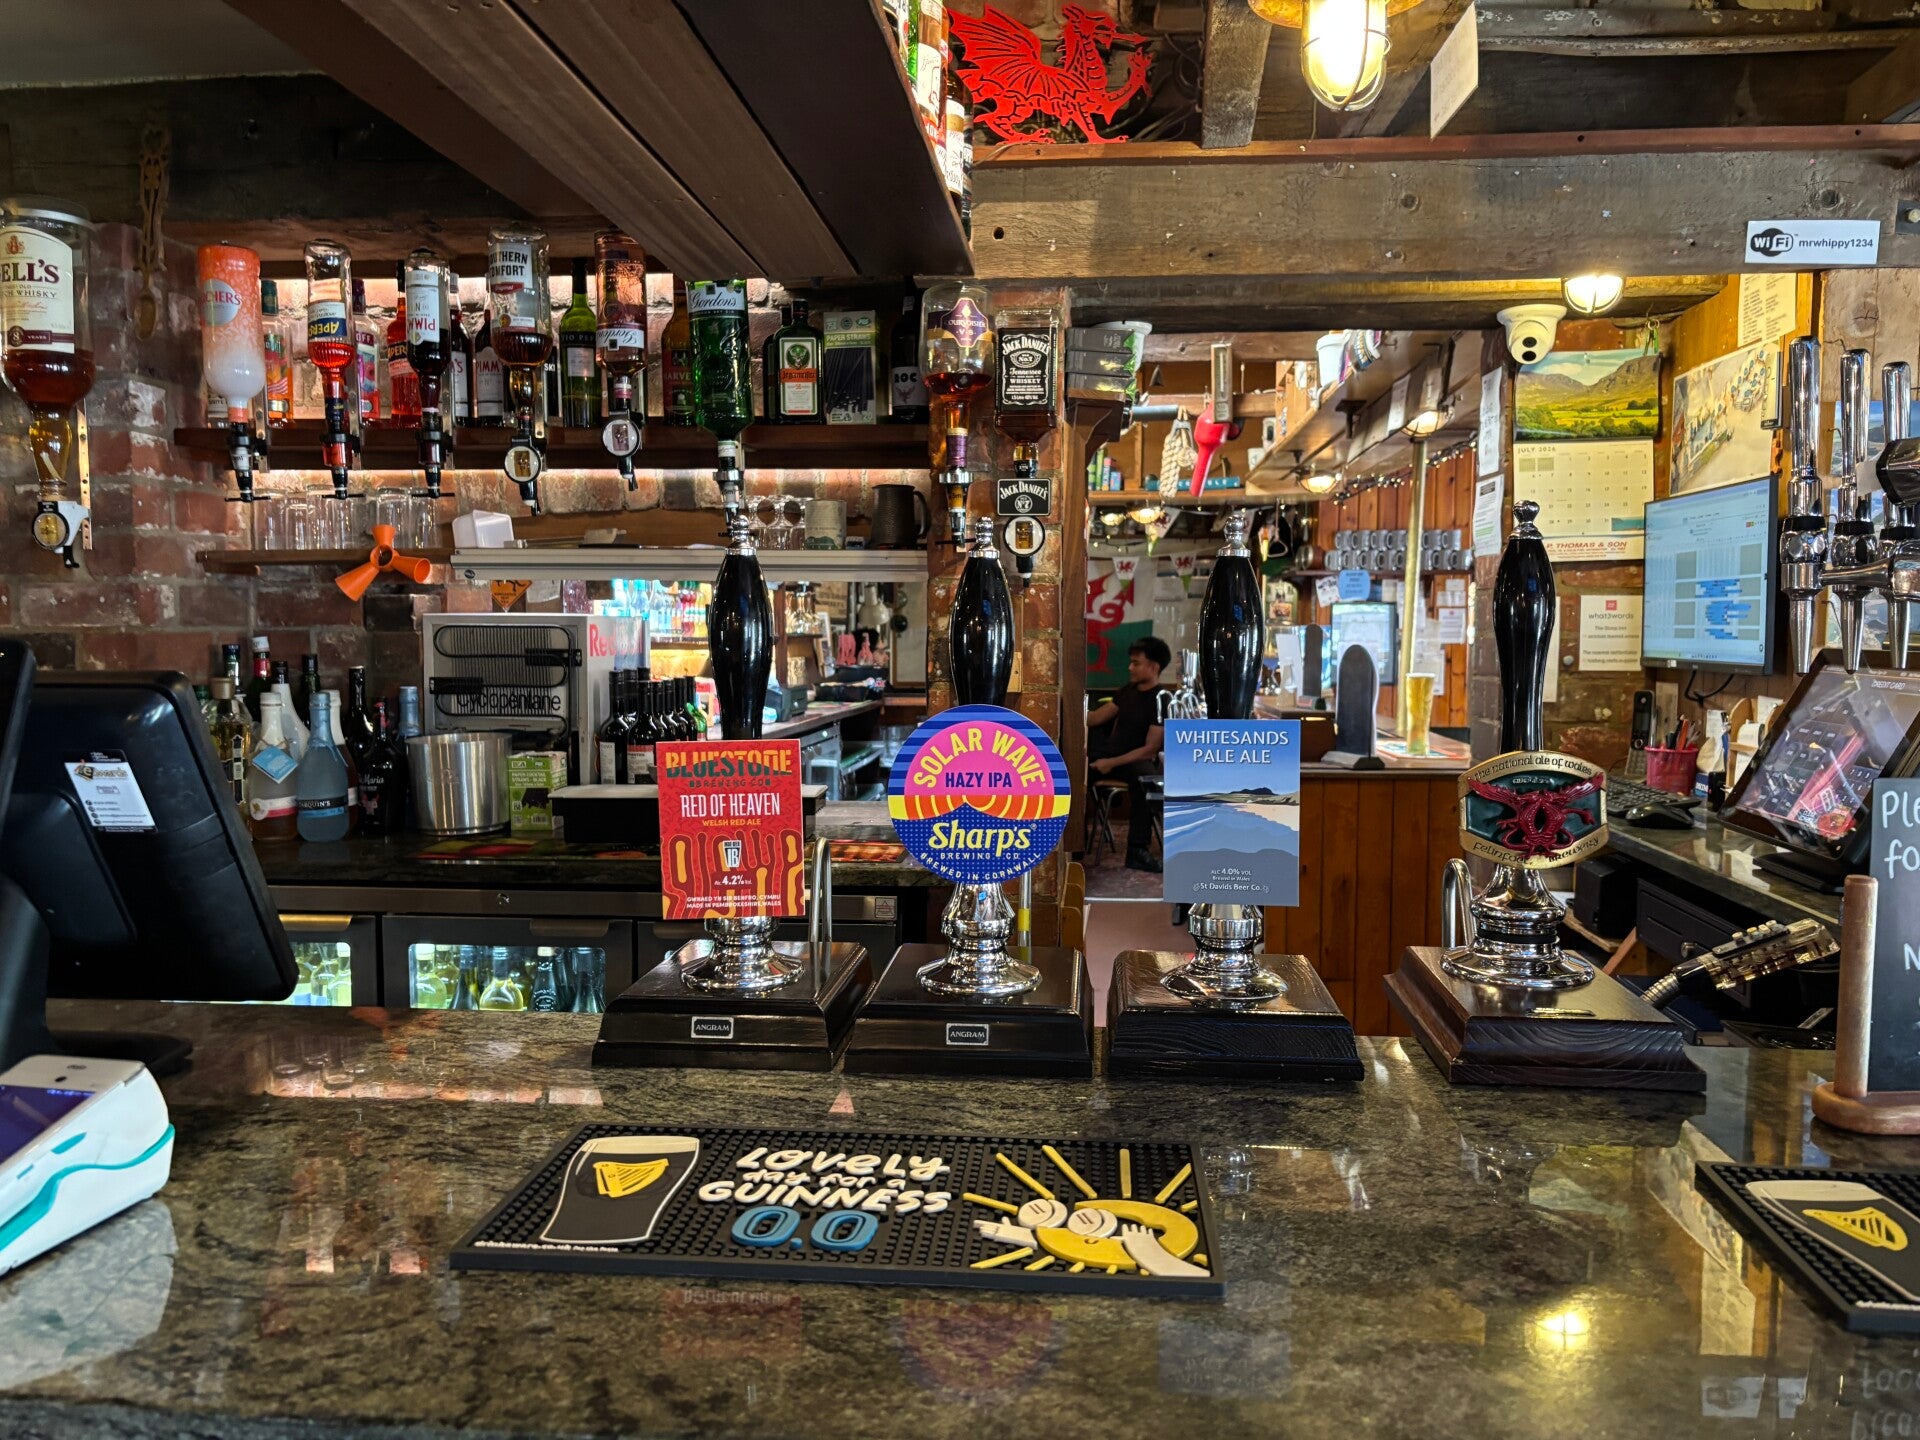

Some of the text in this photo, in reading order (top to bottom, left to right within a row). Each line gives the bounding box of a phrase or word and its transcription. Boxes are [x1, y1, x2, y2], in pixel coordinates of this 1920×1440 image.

[1798, 238, 1873, 249] mrwhippy1234
[0, 259, 60, 284] ELL'S
[16, 290, 57, 298] WHISKY
[691, 291, 737, 309] Gordon's
[1002, 336, 1051, 356] JACK DANIEL'S
[1000, 481, 1049, 500] JACK DANIEL'S
[1588, 612, 1634, 620] what3words
[1176, 730, 1289, 745] WHITESANDS
[913, 728, 1046, 788] SOLAR WAVE
[1193, 749, 1272, 764] PALE ALE
[1492, 754, 1533, 774] national
[1534, 756, 1550, 766] ale
[1552, 757, 1564, 769] of
[946, 772, 1012, 788] HAZY IPA
[680, 792, 780, 818] RED OF HEAVEN
[702, 818, 762, 827] WELSH RED ALE
[928, 818, 1032, 857] Sharp's
[940, 852, 1020, 860] BREWING CO
[1884, 838, 1920, 880] fo
[920, 852, 1041, 881] BREWED IN CORNWALL
[1221, 868, 1240, 876] 4.0%
[722, 875, 745, 885] 4.2%
[1200, 882, 1208, 890] St
[696, 1022, 730, 1034] ANGRAM
[949, 1028, 986, 1040] ANGRAM
[736, 1147, 950, 1181] Lovely
[743, 1169, 906, 1190] day for a
[698, 1180, 952, 1214] GUINNESS
[731, 1205, 880, 1252] 0.0
